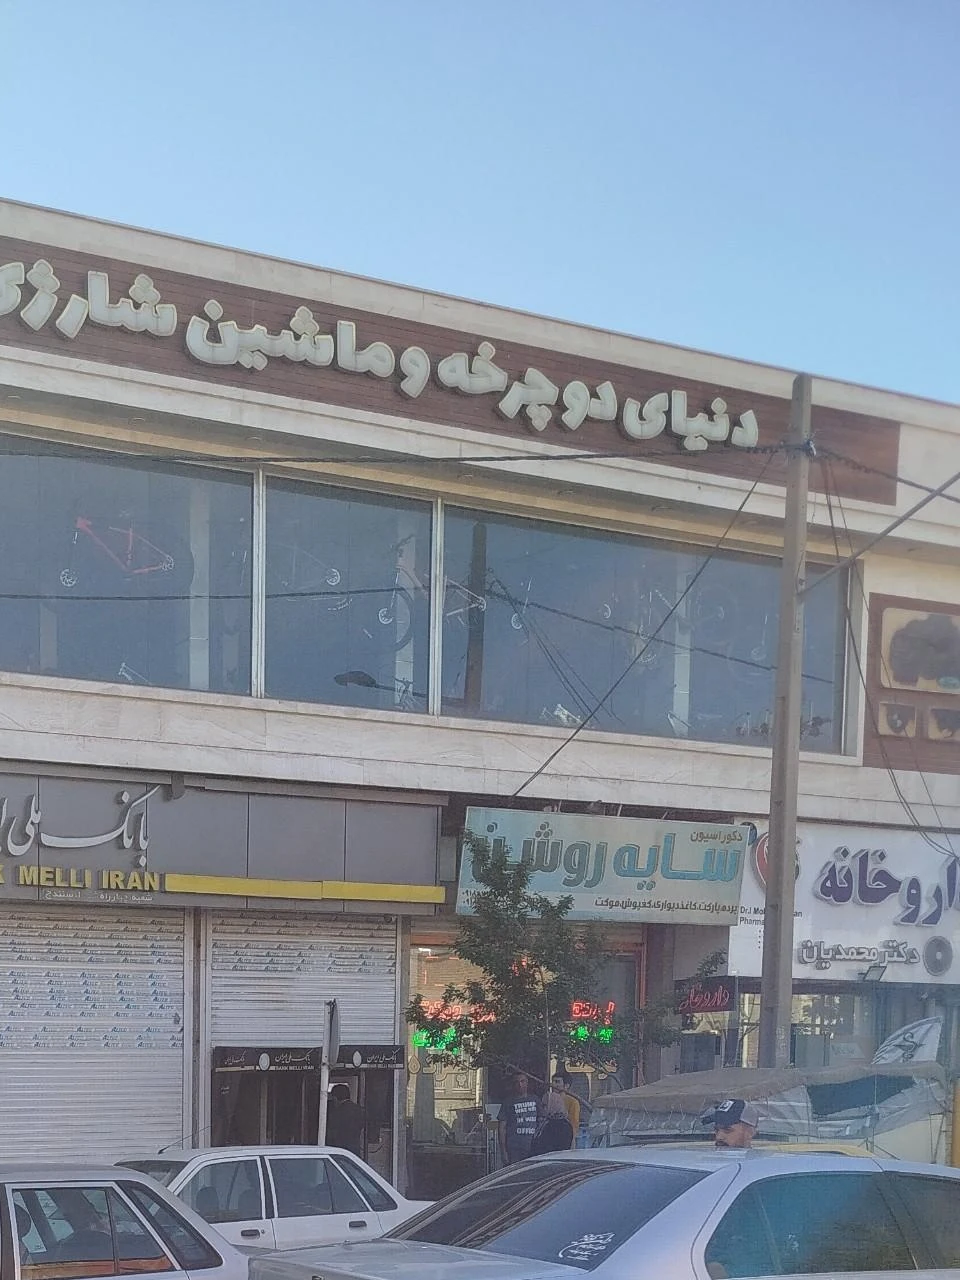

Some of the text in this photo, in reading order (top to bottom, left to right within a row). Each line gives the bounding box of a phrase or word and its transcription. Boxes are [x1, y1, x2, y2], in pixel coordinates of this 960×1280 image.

[439, 341, 617, 432] دوچرخه
[622, 391, 760, 451] دنیای
[7, 793, 42, 857] ملی
[40, 784, 161, 867] بانک
[690, 829, 743, 844] دکوراسیون
[17, 864, 91, 889] MELLI
[102, 869, 160, 892] IRAN
[612, 832, 740, 891] سایه
[816, 847, 960, 927] اروخانه
[798, 939, 880, 970] محمدیان
